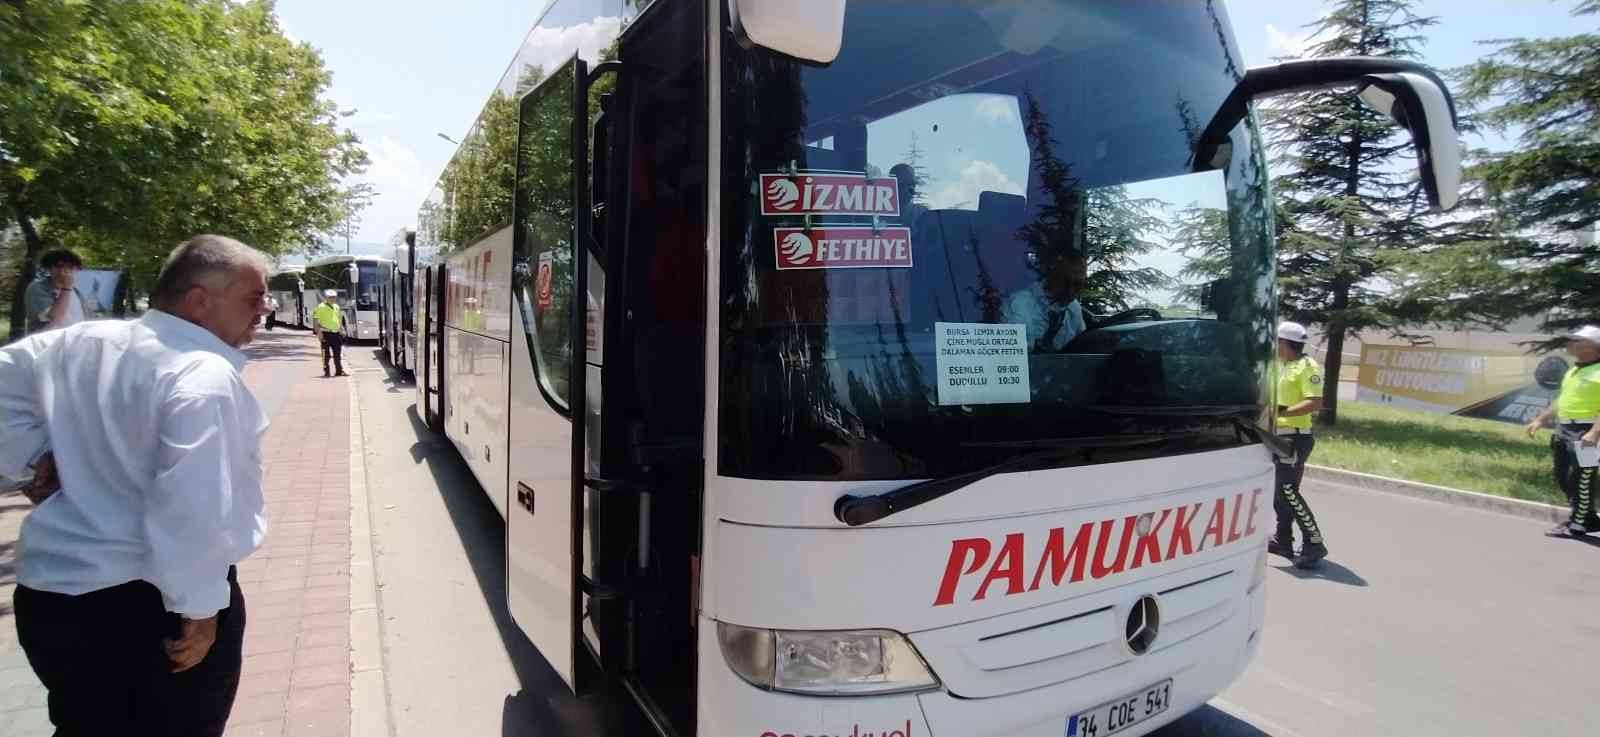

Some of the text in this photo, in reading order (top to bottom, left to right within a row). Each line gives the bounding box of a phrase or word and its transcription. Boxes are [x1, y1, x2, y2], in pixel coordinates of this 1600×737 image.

[815, 235, 908, 262] FETHİYE
[946, 328, 970, 336] BURSA
[949, 365, 1019, 375] ESENLER 09:00
[998, 376, 1020, 385] 10:30
[933, 488, 1263, 606] PAMUKKALE
[1108, 698, 1138, 731] COE
[1145, 684, 1169, 714] 541
